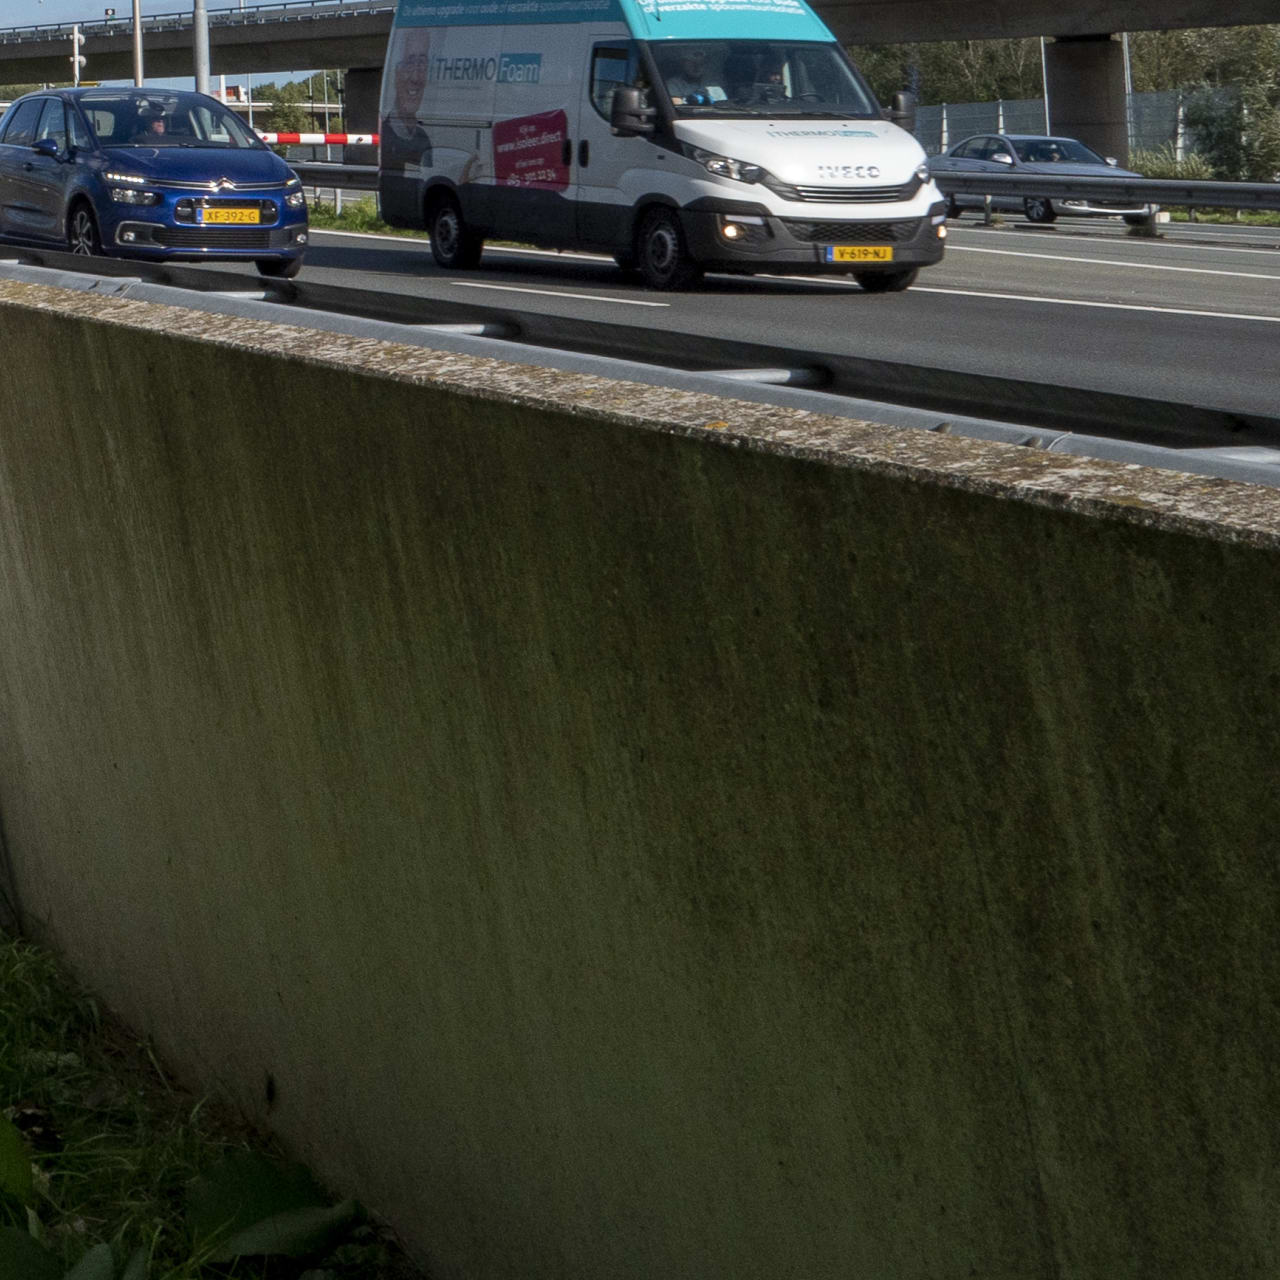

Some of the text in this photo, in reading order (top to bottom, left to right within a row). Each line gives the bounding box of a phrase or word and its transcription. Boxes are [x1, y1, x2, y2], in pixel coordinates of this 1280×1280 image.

[436, 57, 539, 82] THERMO Foam
[818, 166, 880, 179] IVECO
[207, 211, 256, 222] XF-392-G
[837, 248, 887, 260] V-619-NJ
